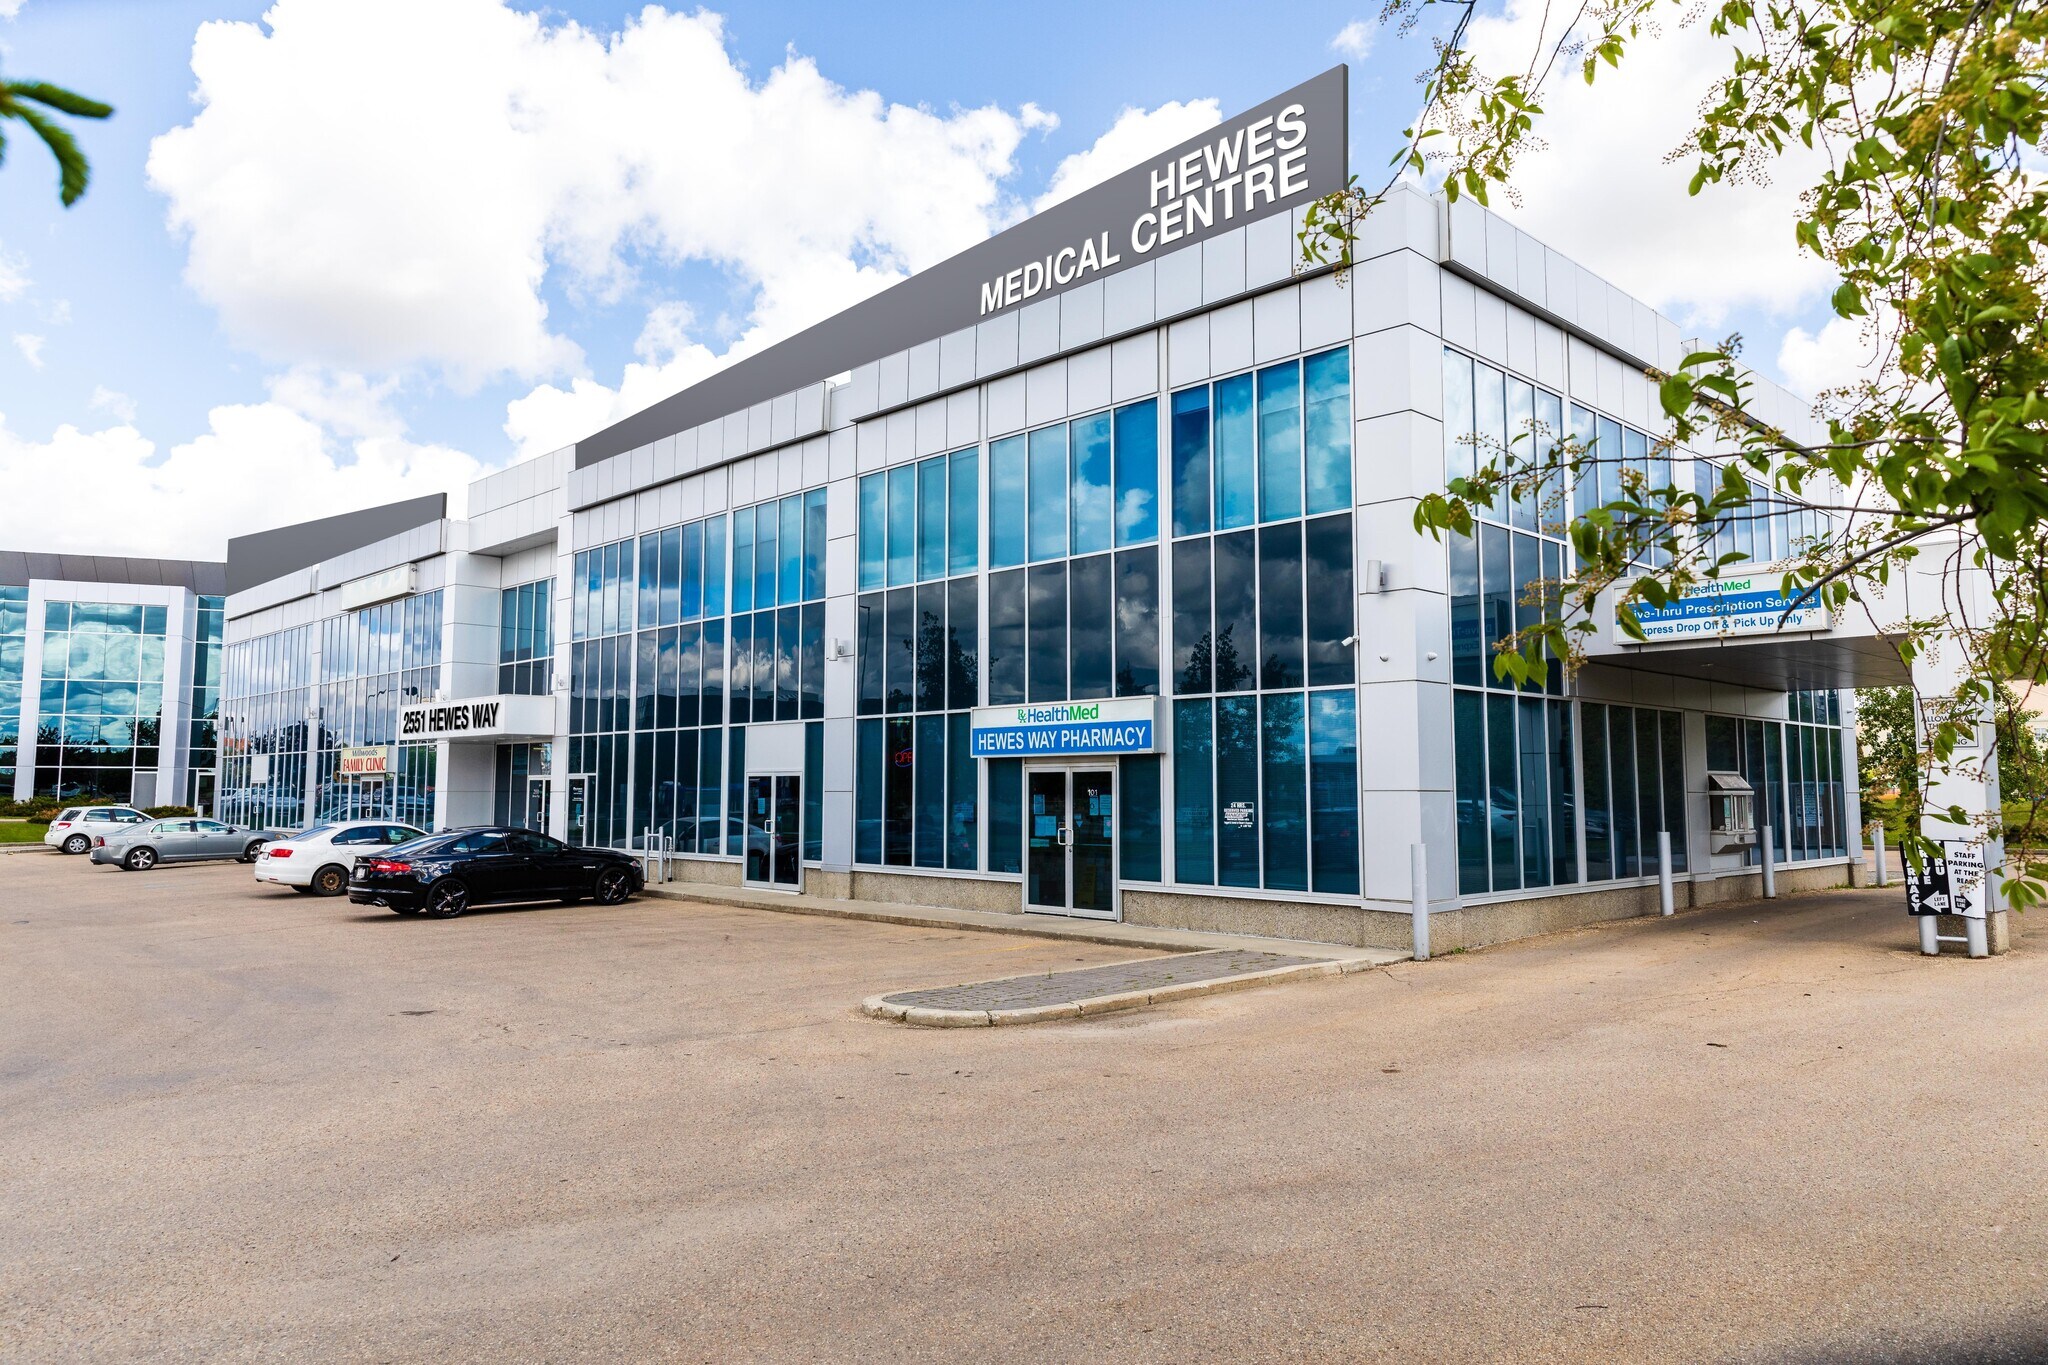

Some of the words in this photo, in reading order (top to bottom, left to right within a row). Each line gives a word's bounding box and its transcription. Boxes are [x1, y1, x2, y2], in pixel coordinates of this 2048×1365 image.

[1150, 103, 1308, 208] HEWES
[980, 231, 1121, 316] MEDICAL
[1131, 146, 1310, 255] CENTRE
[1684, 579, 1751, 594] HealthMed
[1633, 605, 1682, 619] ive-Thru
[1686, 600, 1763, 614] Prescription
[1765, 595, 1816, 608] Servce
[1641, 625, 1674, 636] xpress
[1676, 622, 1701, 633] Drop
[1722, 619, 1730, 629] &
[1734, 617, 1756, 628] Pick
[1759, 616, 1775, 628] Up
[402, 710, 426, 734] 2551
[429, 705, 469, 732] HEWES
[472, 702, 500, 729] WAY
[1027, 703, 1099, 723] HealthMed
[978, 731, 1024, 750] HEWES
[1028, 730, 1057, 749] WAY
[1061, 726, 1146, 748] PHARMACY
[343, 757, 365, 772] FAMILY
[365, 757, 386, 772] CLINIC
[895, 751, 914, 763] OPE
[1917, 843, 1932, 885] RIVE
[1932, 840, 1946, 876] TRU
[1948, 860, 1984, 868] PARKING
[1954, 851, 1976, 860] STAFF
[1904, 842, 1921, 912] ARMACY
